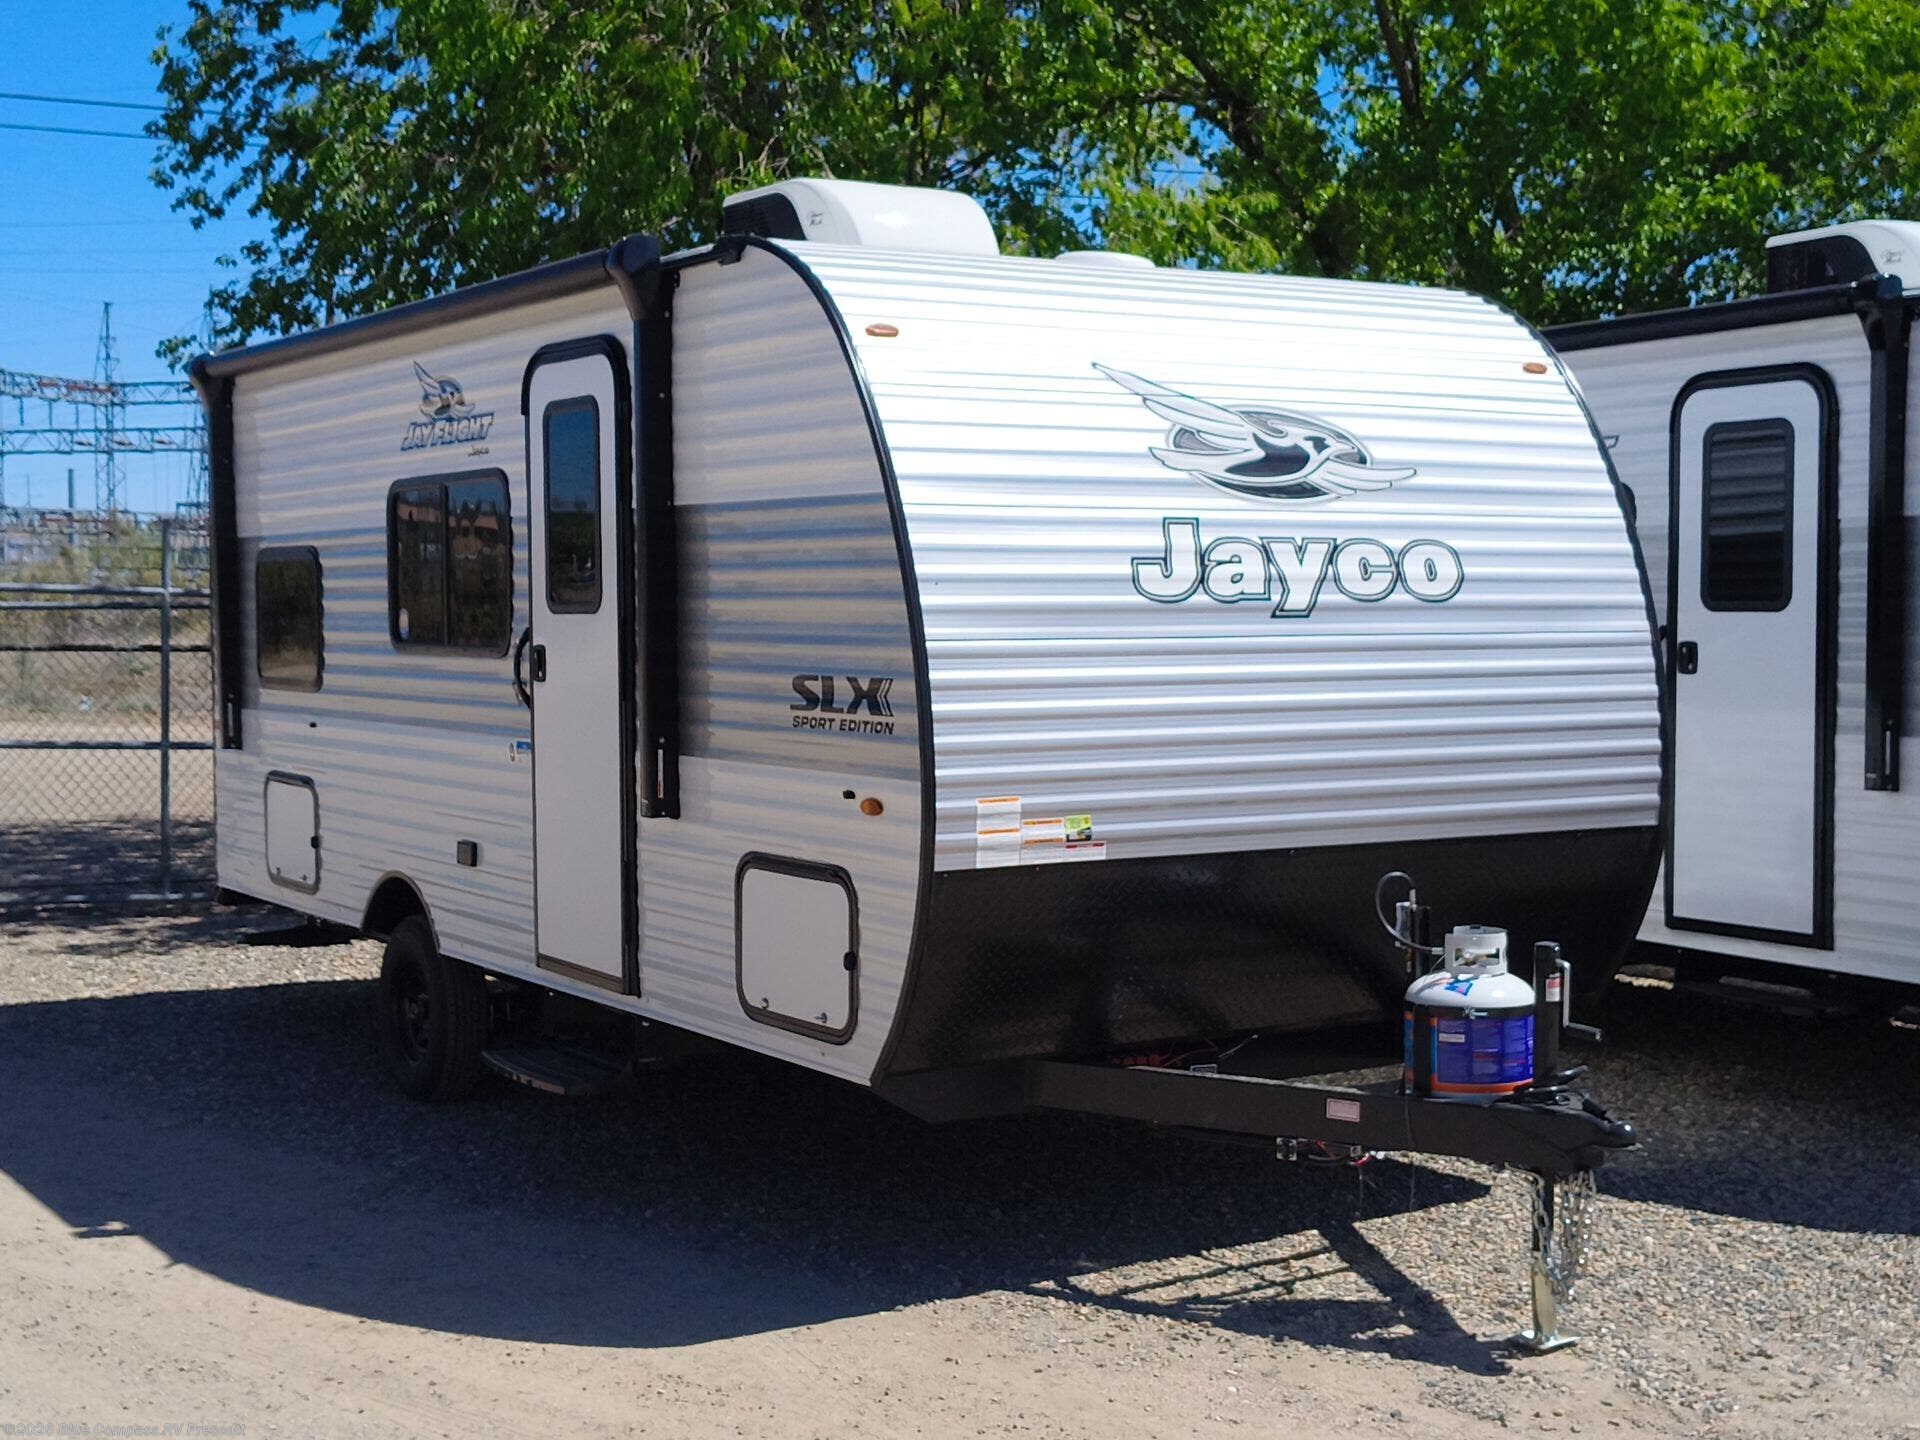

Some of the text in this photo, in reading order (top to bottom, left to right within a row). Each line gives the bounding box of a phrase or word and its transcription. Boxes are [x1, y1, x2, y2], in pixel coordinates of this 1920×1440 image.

[1131, 517, 1464, 618] Jayco
[790, 674, 894, 717] SLX
[792, 715, 894, 735] SPORT EDITION
